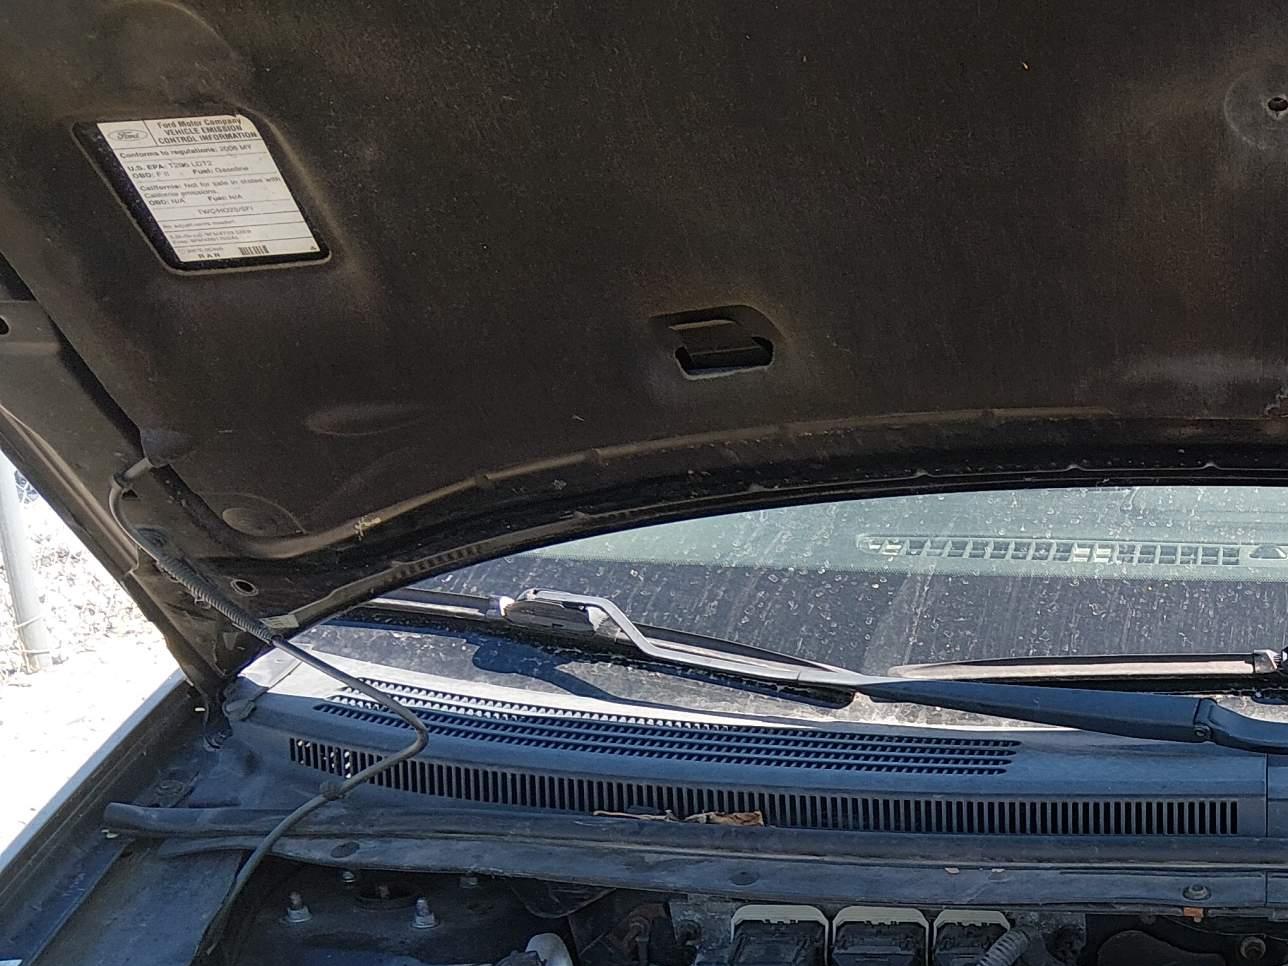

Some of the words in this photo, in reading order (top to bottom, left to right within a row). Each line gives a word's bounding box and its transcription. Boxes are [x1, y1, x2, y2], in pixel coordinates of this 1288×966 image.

[157, 121, 177, 129] Ford
[178, 120, 201, 128] Motor
[203, 118, 242, 128] Company
[164, 127, 198, 136] VEHICLE
[201, 125, 243, 134] EMISSION
[158, 136, 197, 145] CONTROL
[199, 131, 258, 142] INFORMATION
[119, 151, 159, 160] Conforms
